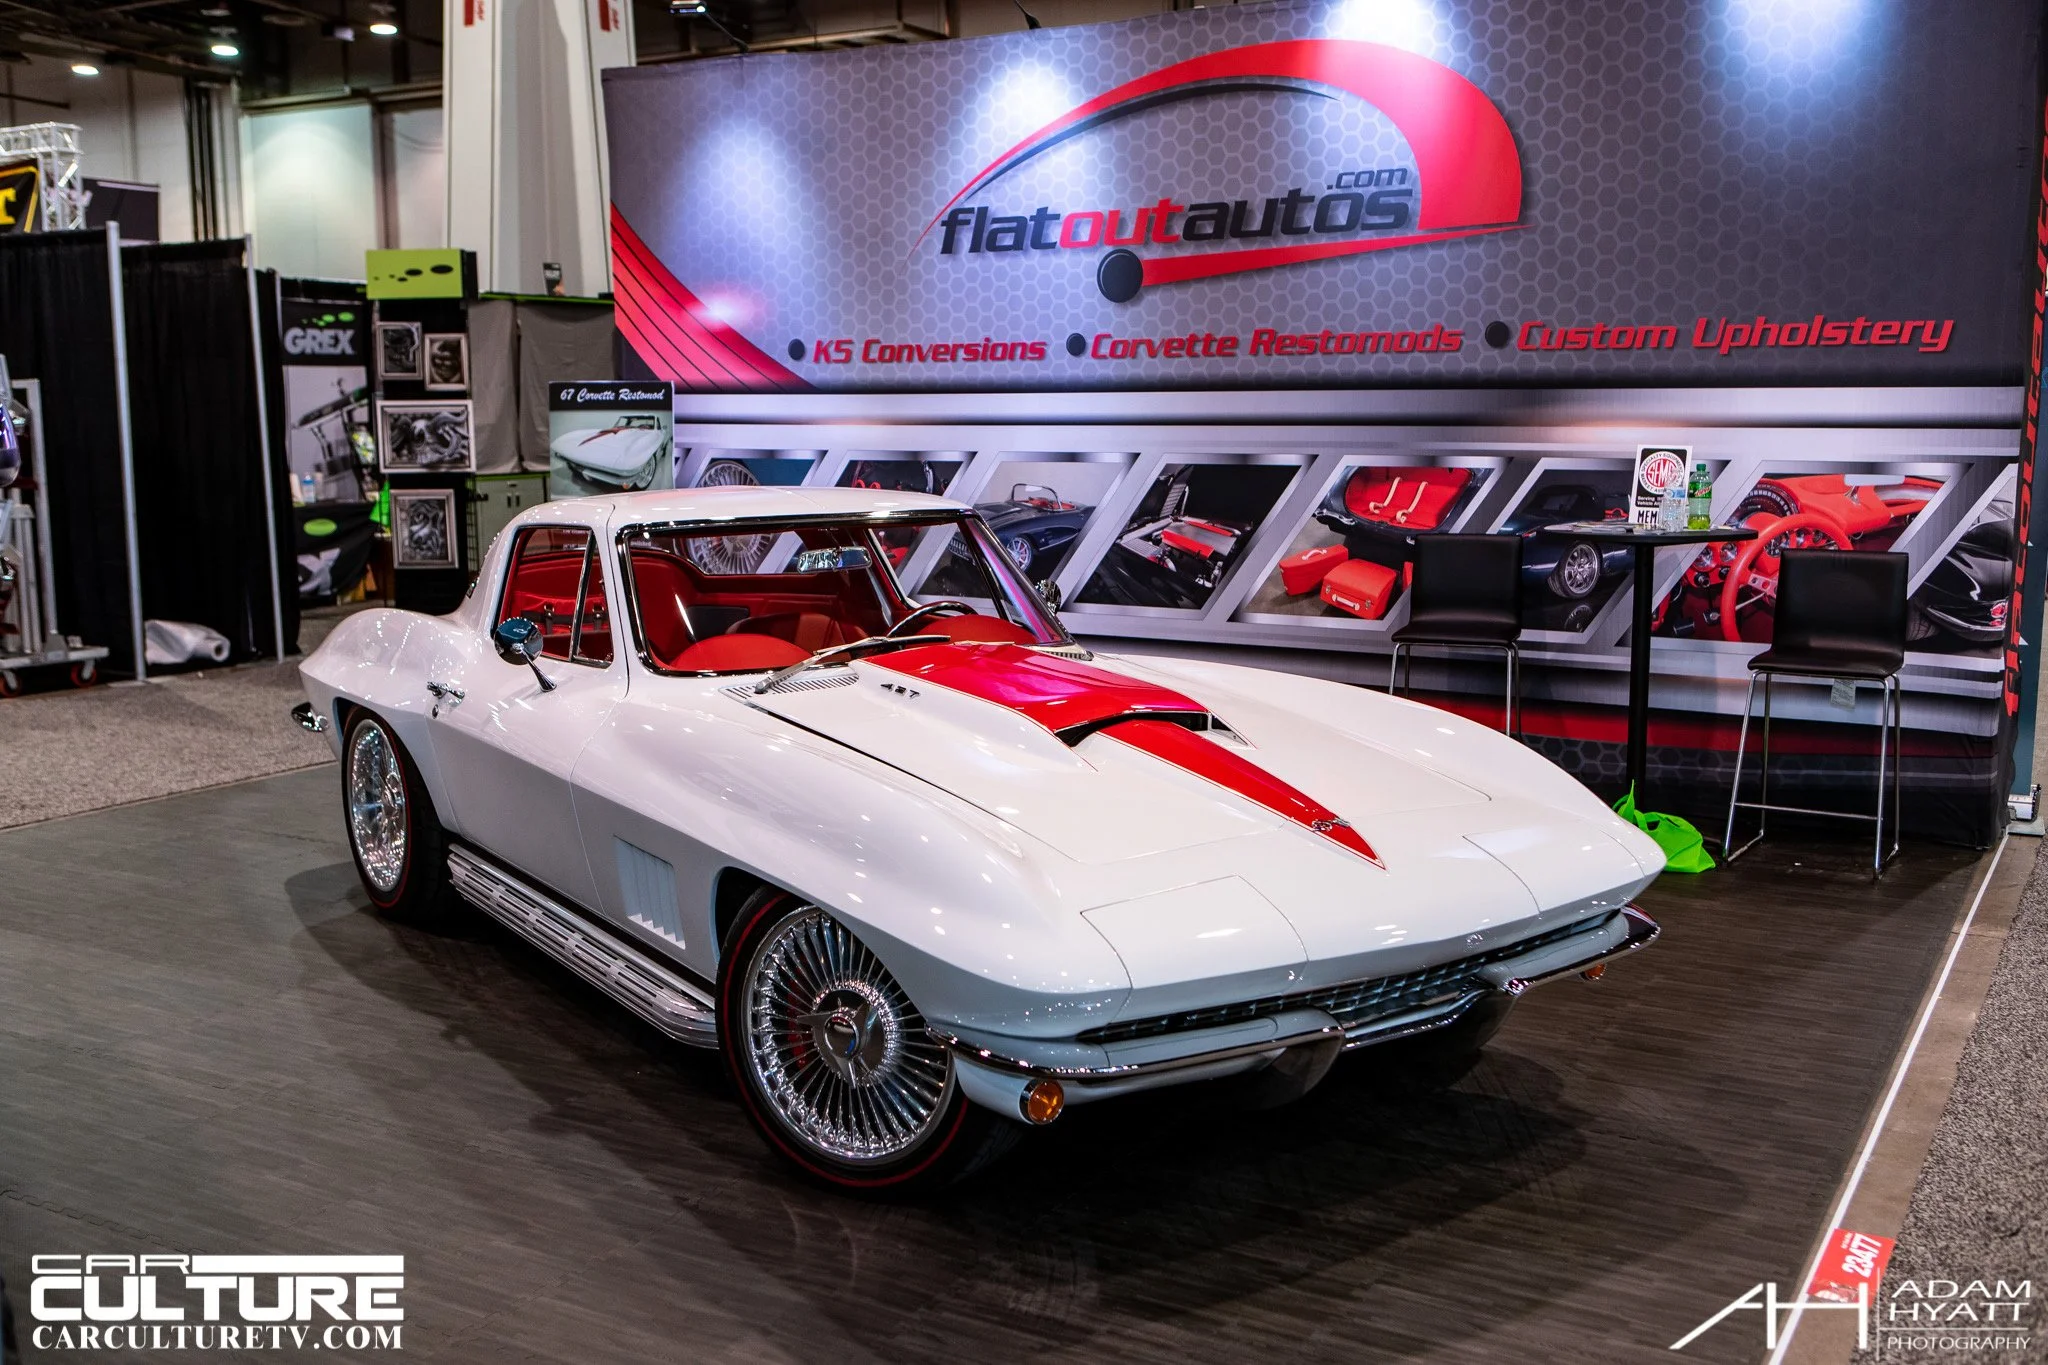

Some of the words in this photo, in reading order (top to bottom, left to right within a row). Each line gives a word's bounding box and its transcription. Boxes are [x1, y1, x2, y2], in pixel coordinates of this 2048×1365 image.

[1326, 167, 1408, 190] .com
[940, 188, 1413, 255] flatoutautos
[284, 327, 355, 355] GREX
[1090, 332, 1238, 359] Corvette
[1248, 323, 1465, 356] Restomods
[1517, 320, 1678, 350] Custom
[1692, 314, 1955, 355] Upholstery
[861, 336, 1048, 364] Conversions
[560, 388, 575, 401] 67
[577, 387, 615, 403] Corvette
[618, 387, 665, 401] Restomod
[2005, 96, 2048, 717] flatoutaut
[1637, 510, 1659, 524] MEM
[880, 683, 920, 699] 427
[1841, 1233, 1882, 1278] 23477
